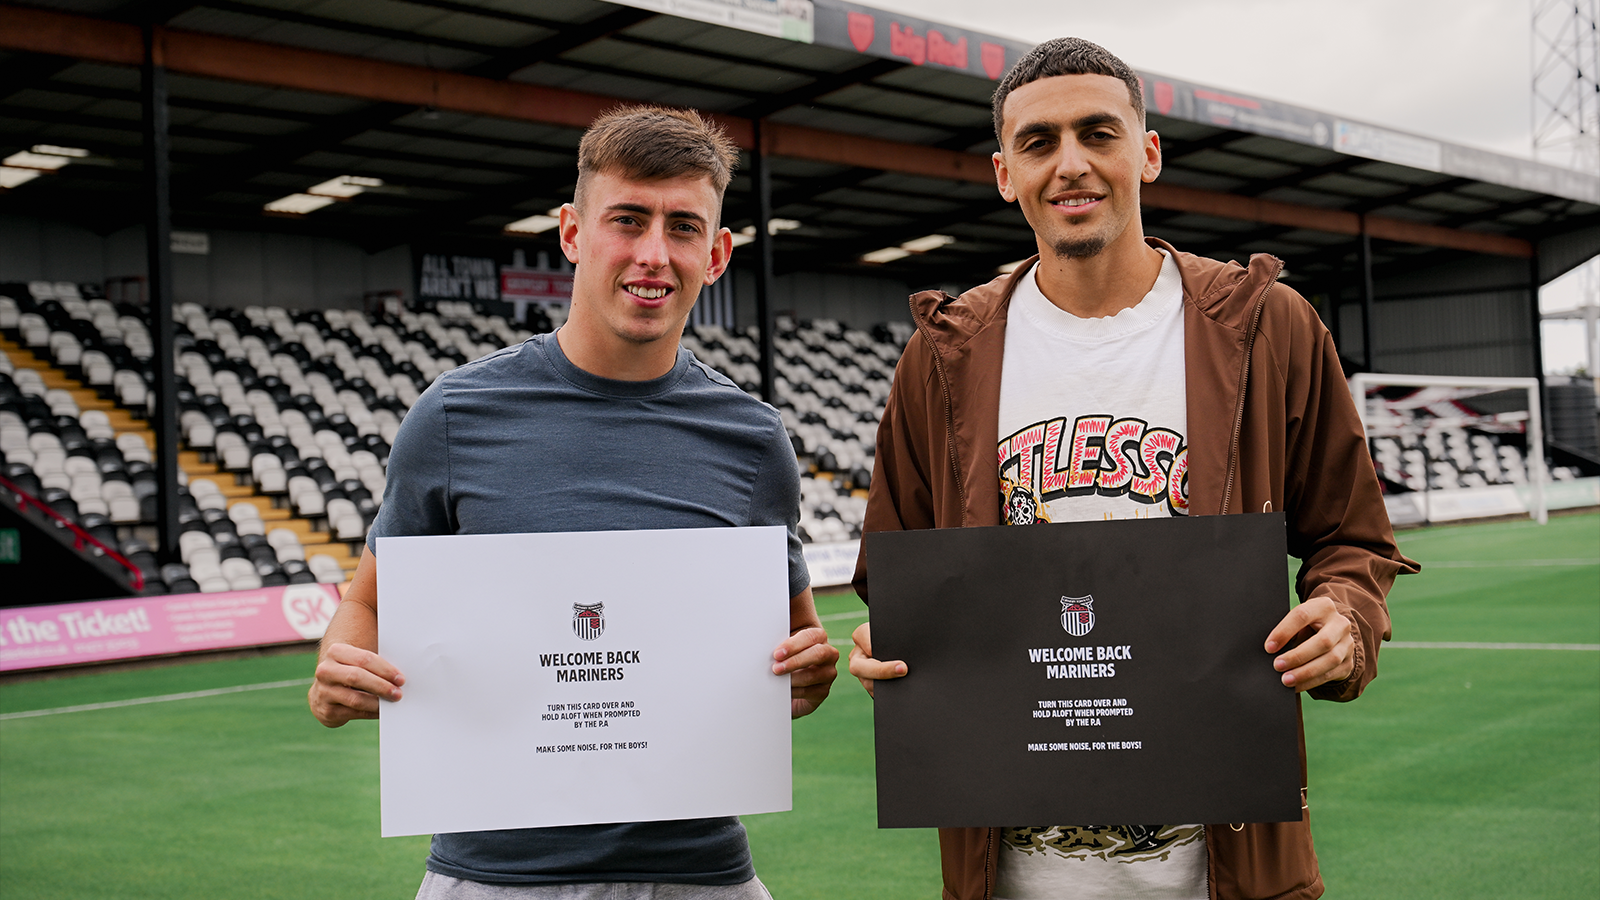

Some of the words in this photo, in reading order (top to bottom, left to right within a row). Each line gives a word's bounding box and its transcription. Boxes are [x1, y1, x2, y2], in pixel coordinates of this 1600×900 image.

[890, 22, 926, 65] big
[927, 30, 968, 69] Red
[422, 254, 449, 277] ALL
[451, 256, 496, 280] TOWN
[290, 597, 331, 626] SK
[7, 615, 60, 645] the
[57, 606, 152, 640] Ticket!
[539, 651, 604, 668] WELCOME
[606, 650, 641, 665] BACK
[1028, 646, 1094, 663] WELCOME
[1096, 645, 1132, 661] BACK
[556, 667, 625, 683] MARINERS
[1046, 663, 1116, 679] MARINERS
[547, 703, 566, 712] TURN
[567, 702, 582, 711] THIS
[583, 702, 601, 710] CARD
[602, 701, 620, 709] OVER
[620, 700, 635, 709] AND
[1038, 700, 1057, 709] TURN
[1058, 699, 1073, 708] THIS
[1074, 699, 1092, 708] CARD
[1093, 699, 1112, 707] OVER
[1112, 698, 1127, 707] AND
[541, 713, 560, 721] HOLD
[560, 712, 581, 720] ALOFT
[583, 711, 603, 719] WHEN
[604, 709, 641, 719] PROMPTED
[1032, 709, 1051, 718] HOLD
[1051, 709, 1073, 717] ALOFT
[1074, 708, 1095, 717] WHEN
[1095, 707, 1134, 717] PROMPTED
[574, 721, 583, 729] BY
[584, 720, 597, 728] THE
[598, 719, 609, 728] P.A
[1065, 718, 1075, 727] BY
[1076, 718, 1090, 726] THE
[1090, 718, 1101, 726] P.A
[535, 745, 556, 754] MAKE
[557, 744, 576, 753] SOME
[577, 743, 598, 752] NOISE,
[599, 743, 613, 751] FOR
[614, 742, 627, 750] THE
[628, 741, 648, 750] BOYS!
[1027, 743, 1048, 752] MAKE
[1048, 743, 1069, 751] SOME
[1069, 742, 1091, 751] NOISE,
[1092, 742, 1106, 750] FOR
[1106, 741, 1120, 750] THE
[1121, 741, 1142, 750] BOYS!
